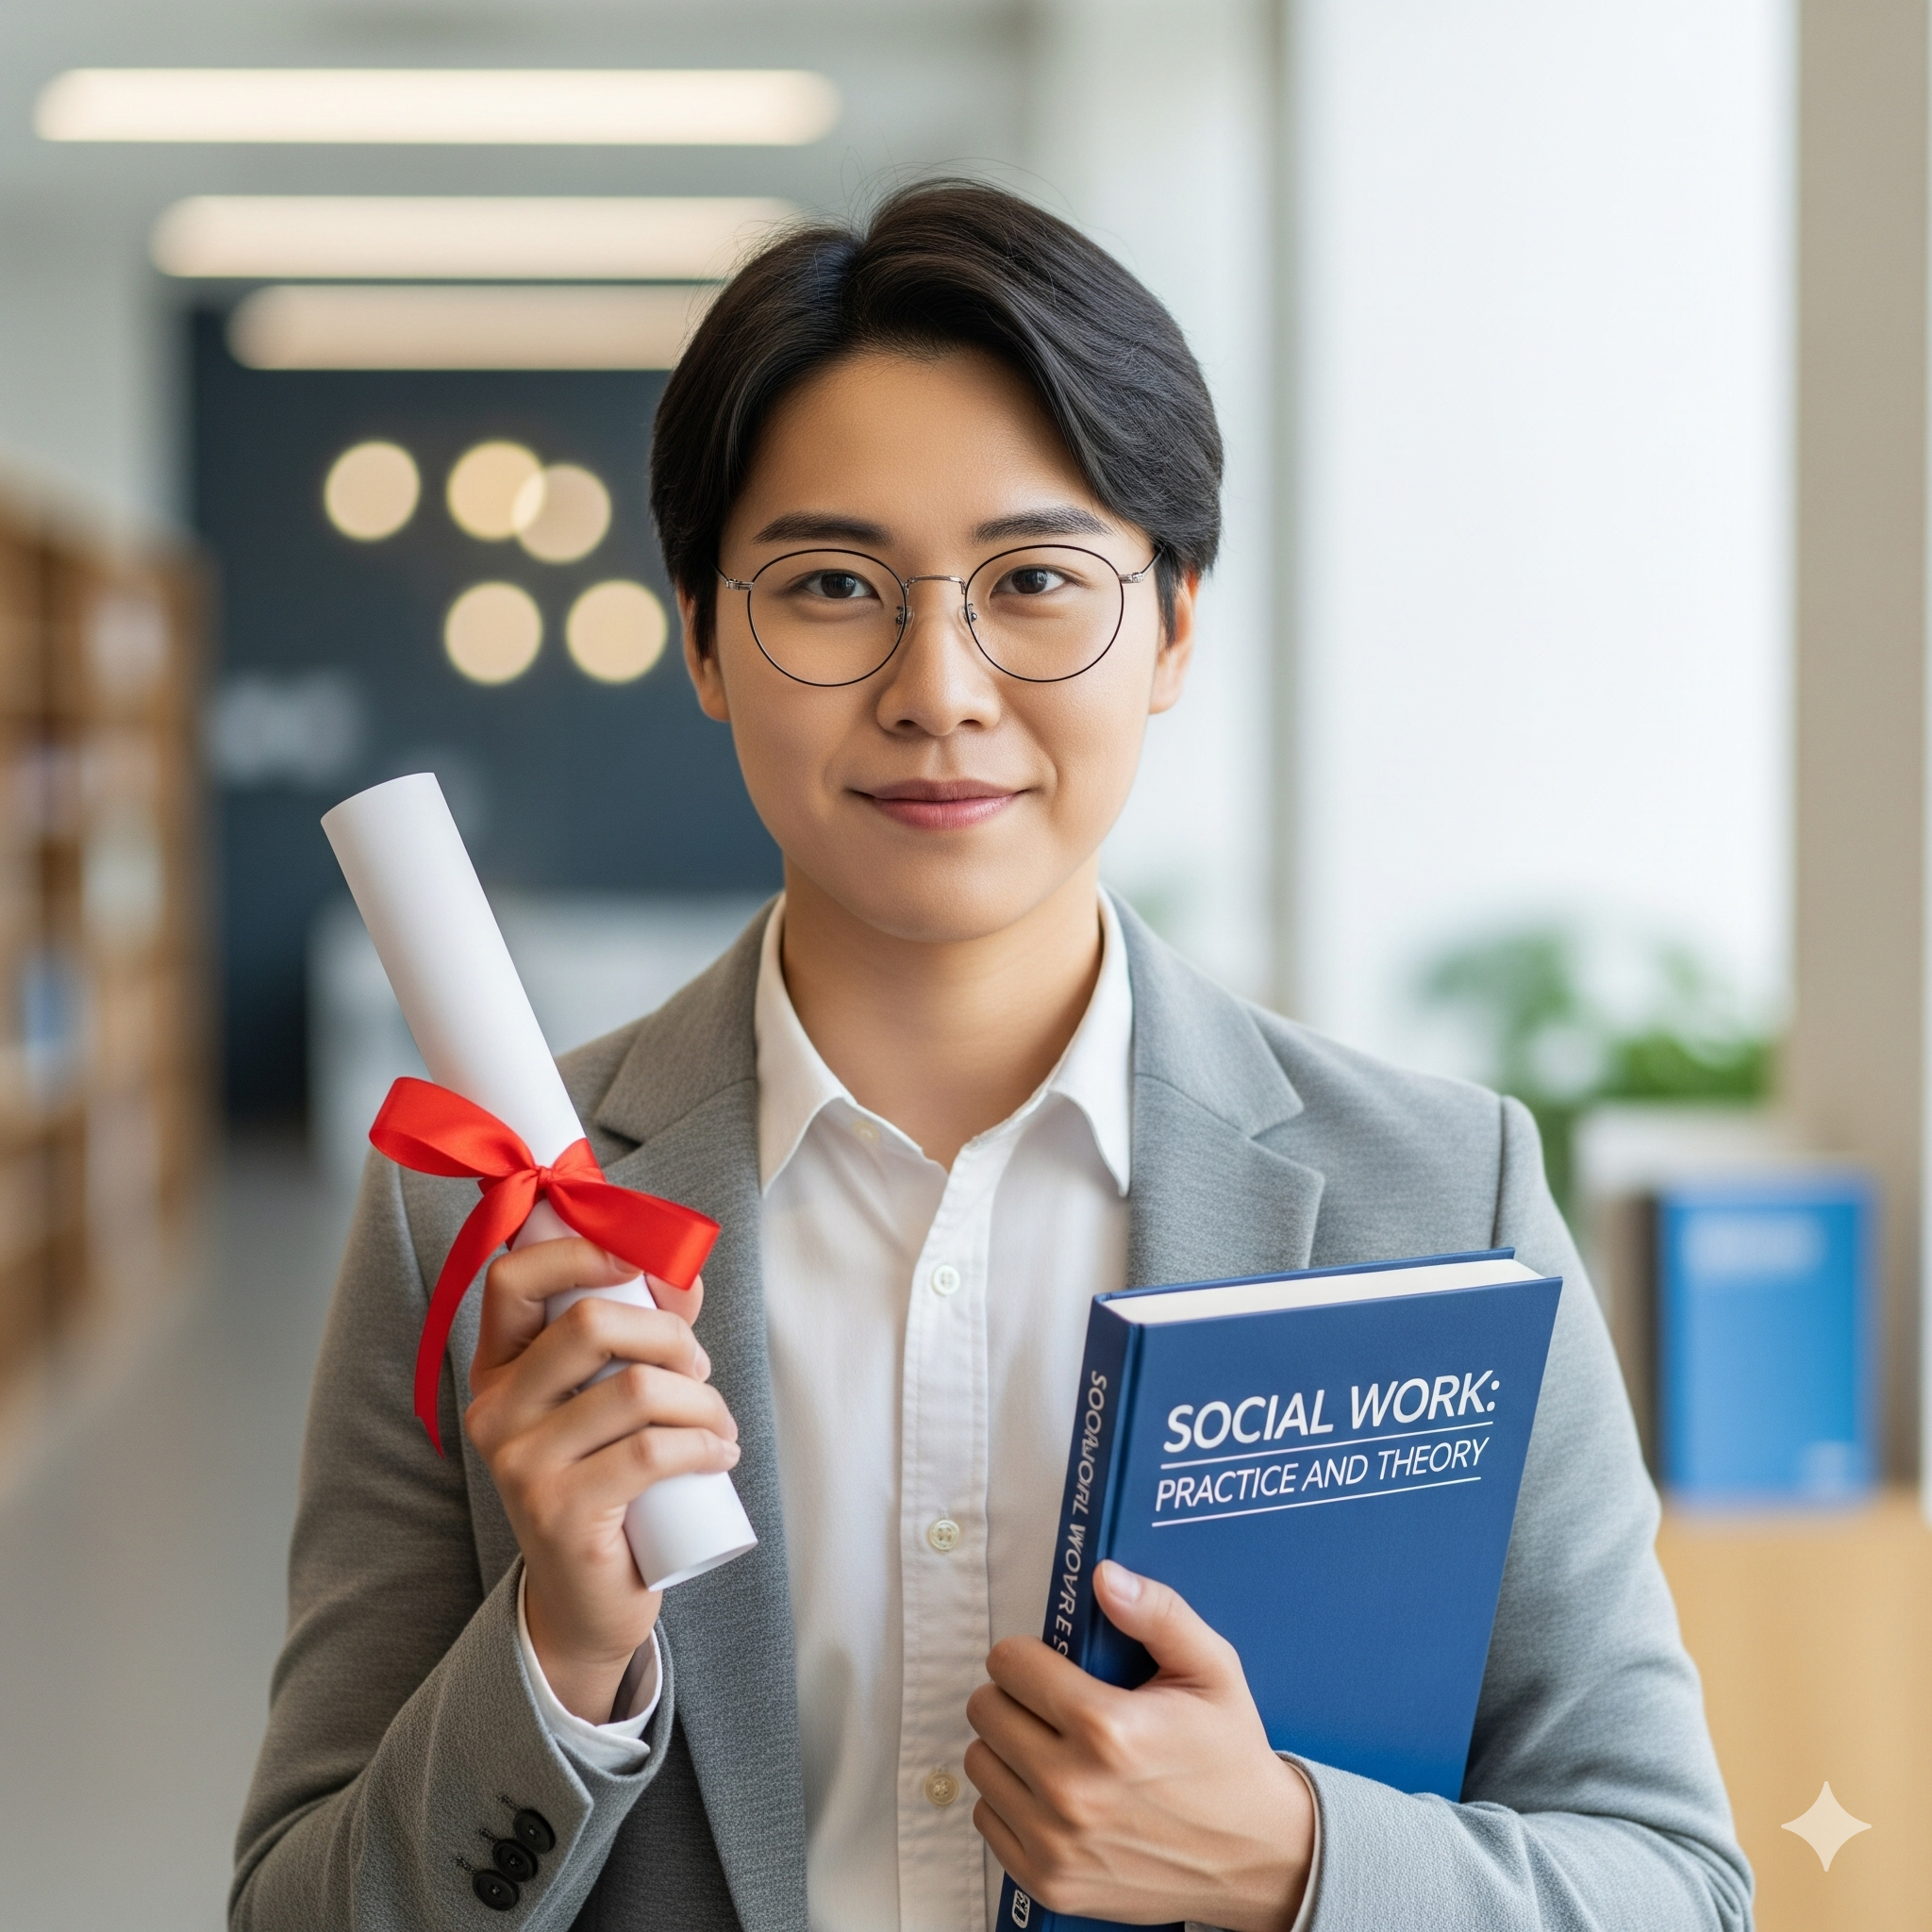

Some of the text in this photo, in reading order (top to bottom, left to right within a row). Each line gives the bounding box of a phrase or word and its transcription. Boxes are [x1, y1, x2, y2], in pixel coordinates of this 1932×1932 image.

[1163, 1370, 1501, 1454] SOCIAL WORK:
[1156, 1437, 1491, 1511] PRACTICE AND THEORY
